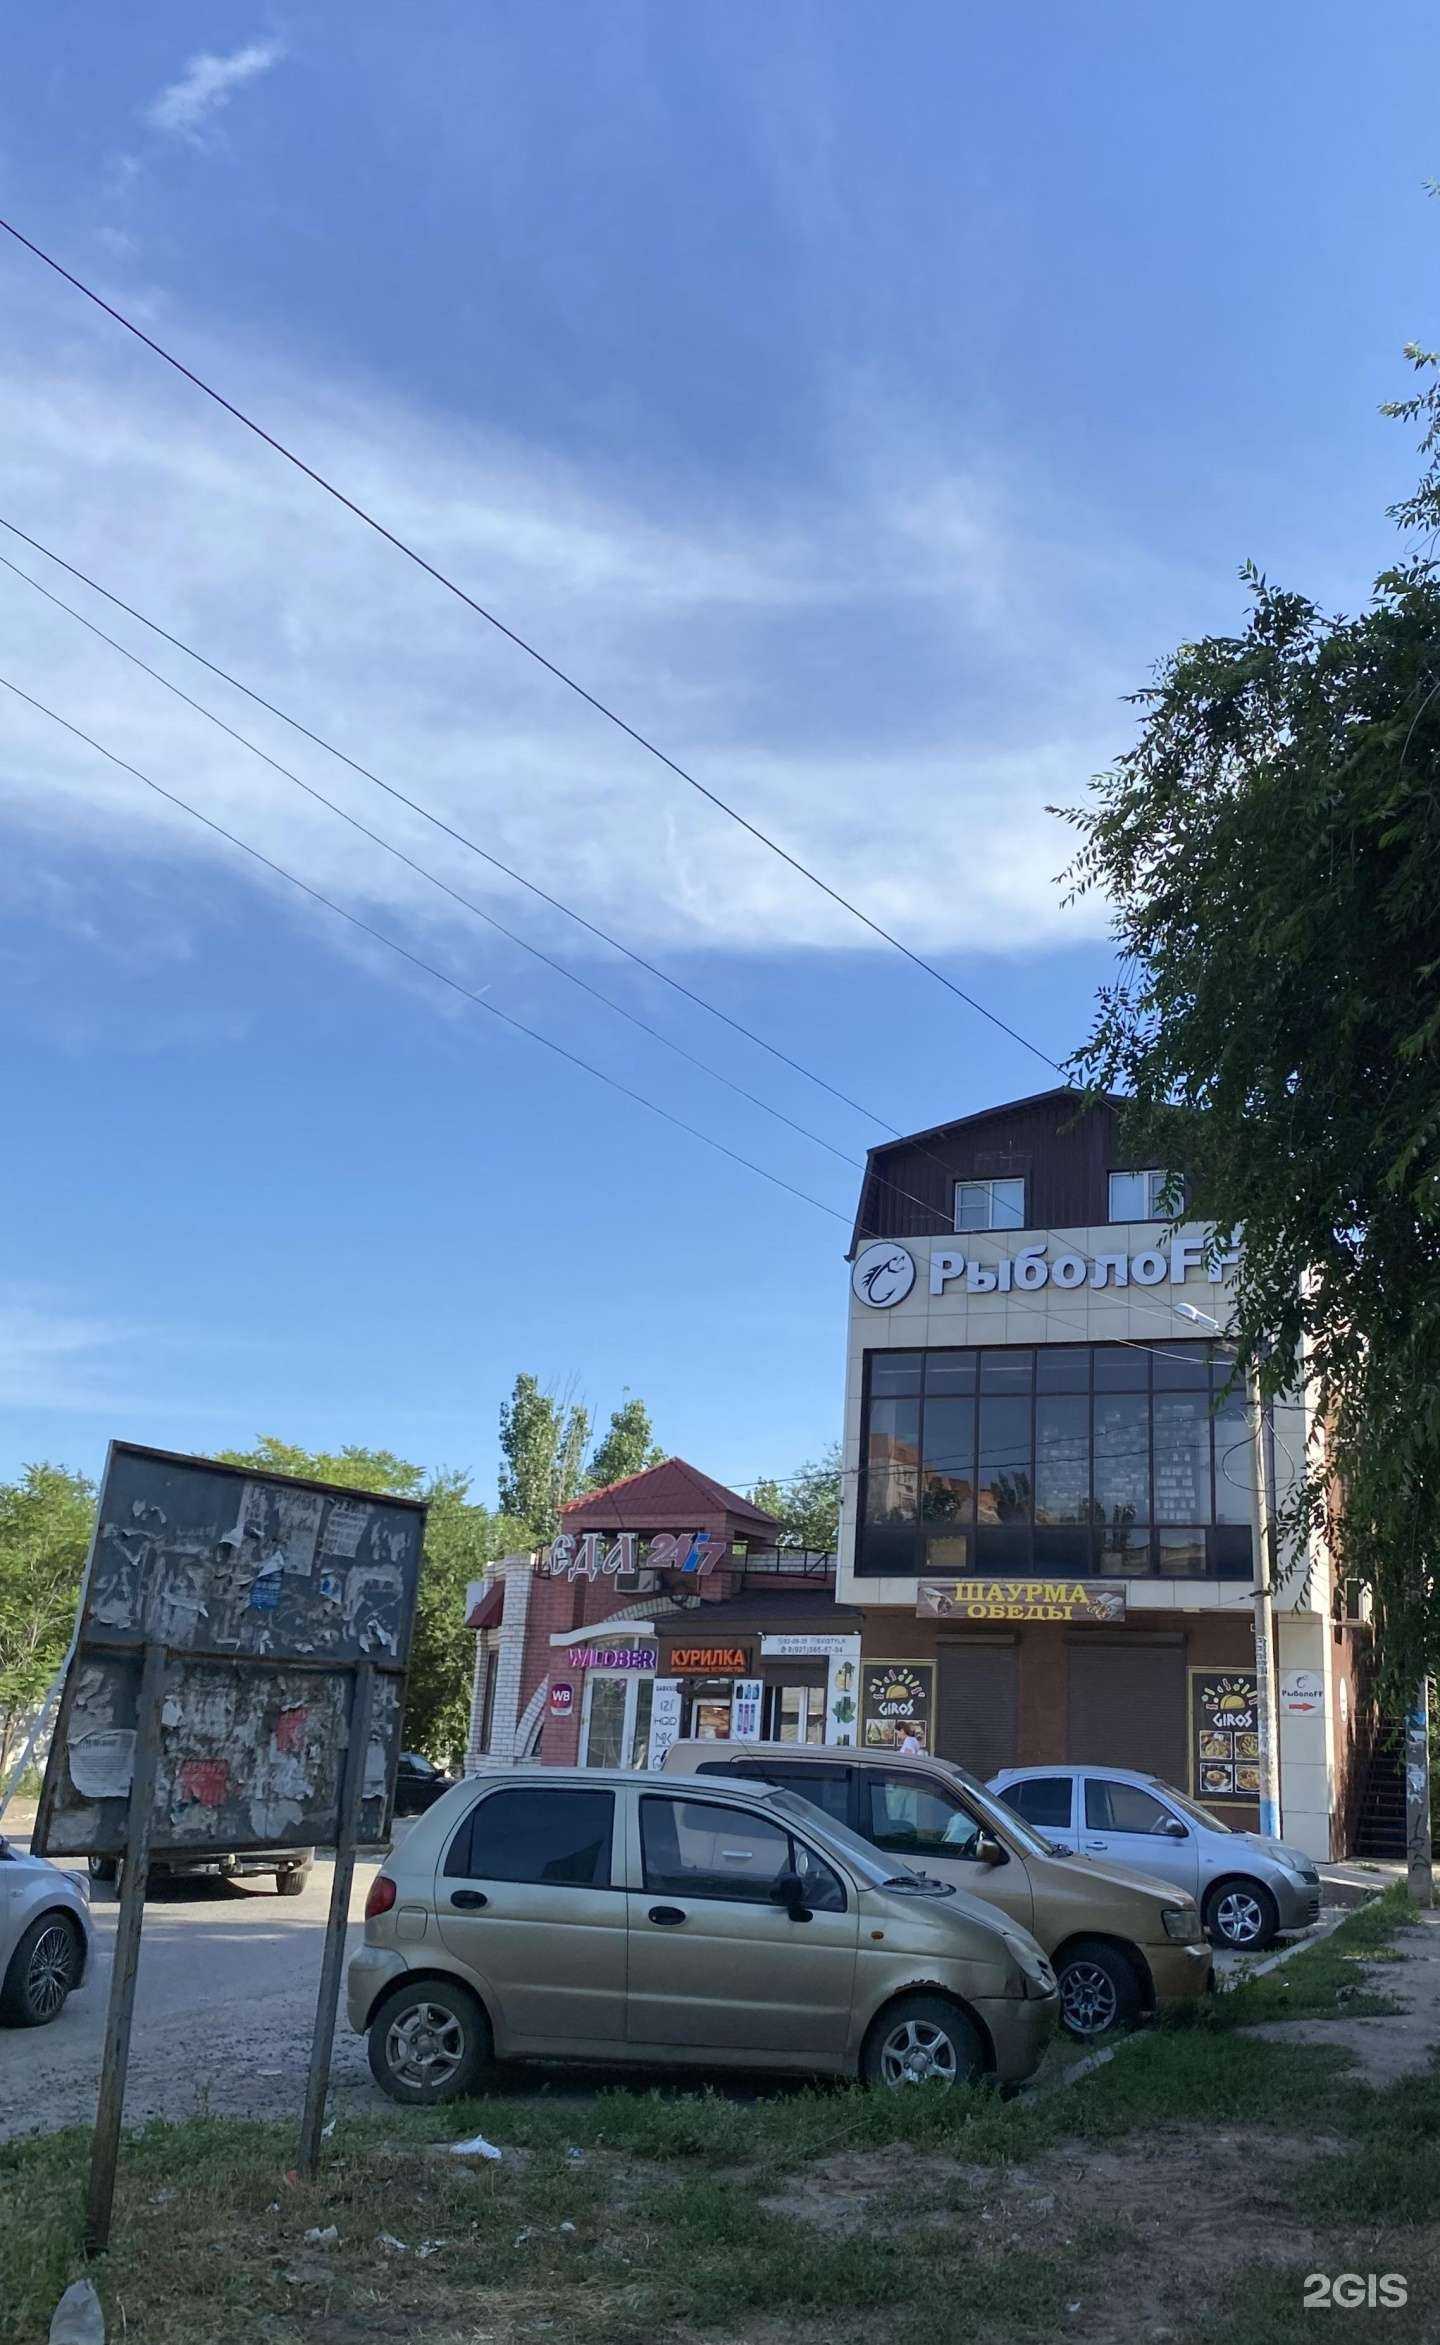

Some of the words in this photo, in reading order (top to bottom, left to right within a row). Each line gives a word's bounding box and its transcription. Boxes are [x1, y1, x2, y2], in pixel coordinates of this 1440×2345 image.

[647, 1532, 727, 1576] 24/7
[955, 1582, 1089, 1604] ШАУРМА
[967, 1604, 1073, 1620] ОБЕДЫ
[671, 1649, 744, 1666] КУРИЛКА
[552, 1690, 571, 1702] WB
[879, 1699, 914, 1716] GIROS
[1212, 1710, 1253, 1728] GIROS
